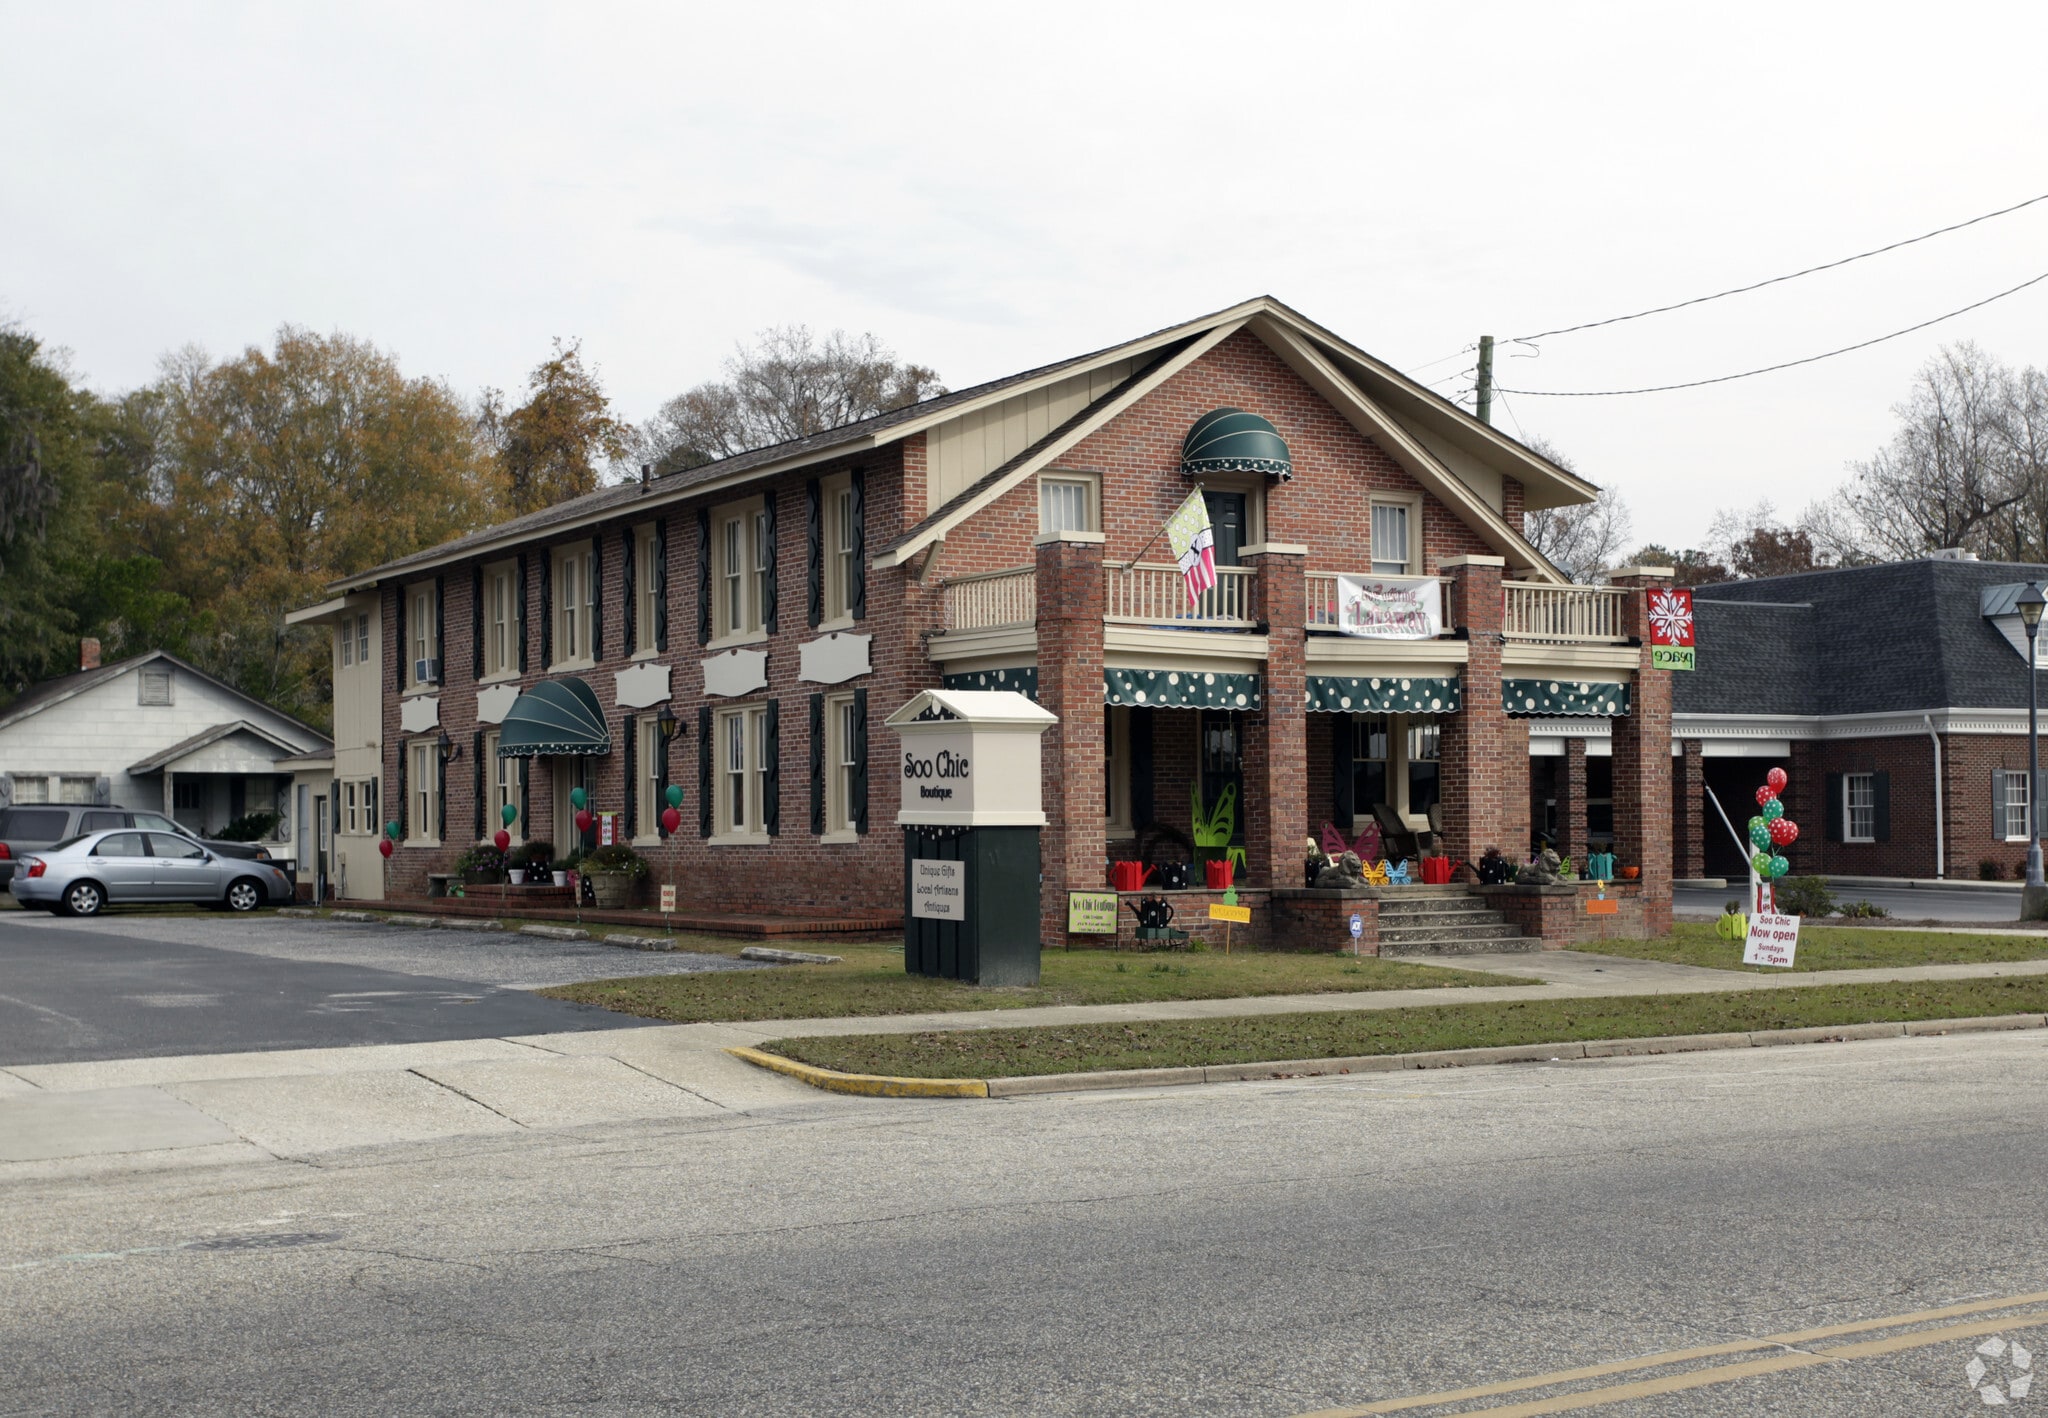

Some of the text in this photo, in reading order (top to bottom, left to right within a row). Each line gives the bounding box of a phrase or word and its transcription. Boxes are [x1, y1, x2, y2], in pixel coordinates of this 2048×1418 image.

[903, 749, 969, 779] Soo Chic
[920, 785, 953, 802] Boutique
[920, 864, 956, 879] Unique Gifts
[916, 883, 959, 897] Local Artisans
[924, 900, 950, 915] Antiques
[1759, 915, 1791, 926] Soo Chic
[1750, 925, 1796, 943] Now open
[1758, 943, 1784, 954] Sundays
[1767, 954, 1788, 965] 5pm
